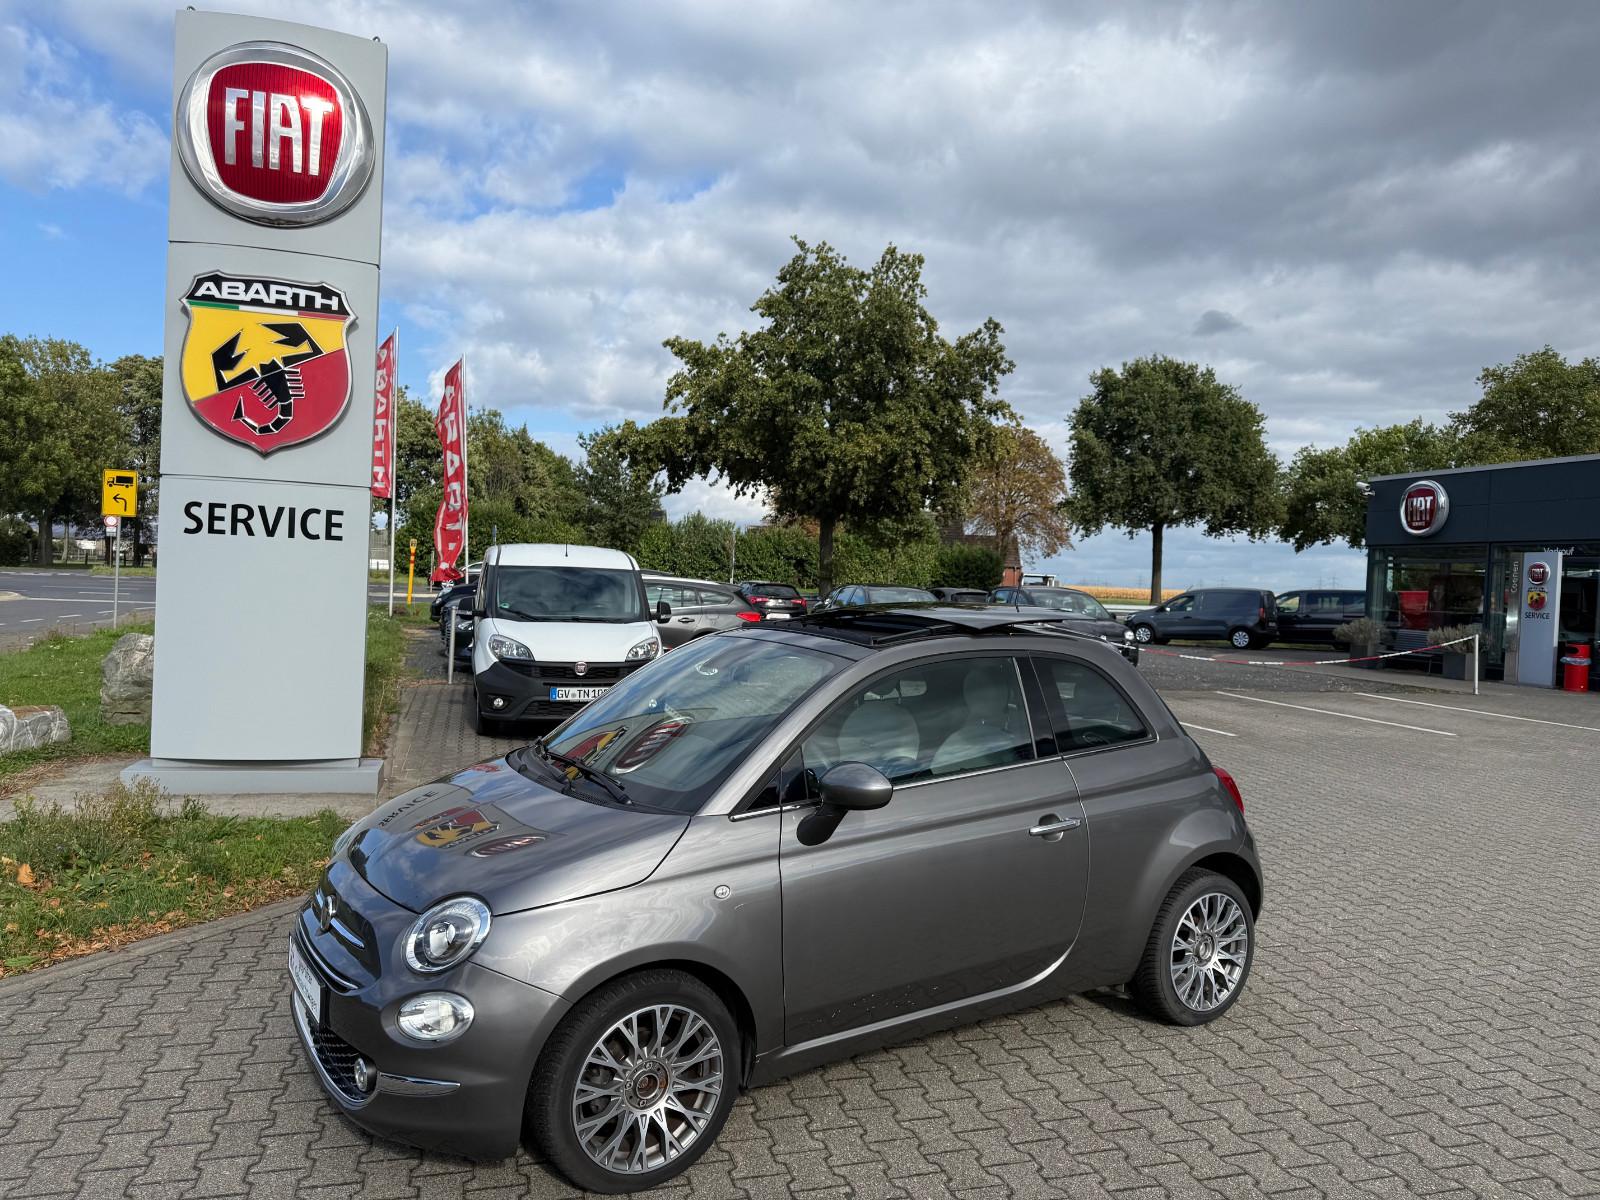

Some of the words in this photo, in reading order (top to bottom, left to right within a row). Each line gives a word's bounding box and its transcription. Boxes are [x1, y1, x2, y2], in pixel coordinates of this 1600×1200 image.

[225, 87, 334, 177] FIAT
[194, 281, 339, 311] ABARTH
[183, 501, 344, 541] SERVICE
[1407, 496, 1434, 521] FIAT
[1524, 611, 1550, 620] SERVICE
[557, 689, 570, 698] GV
